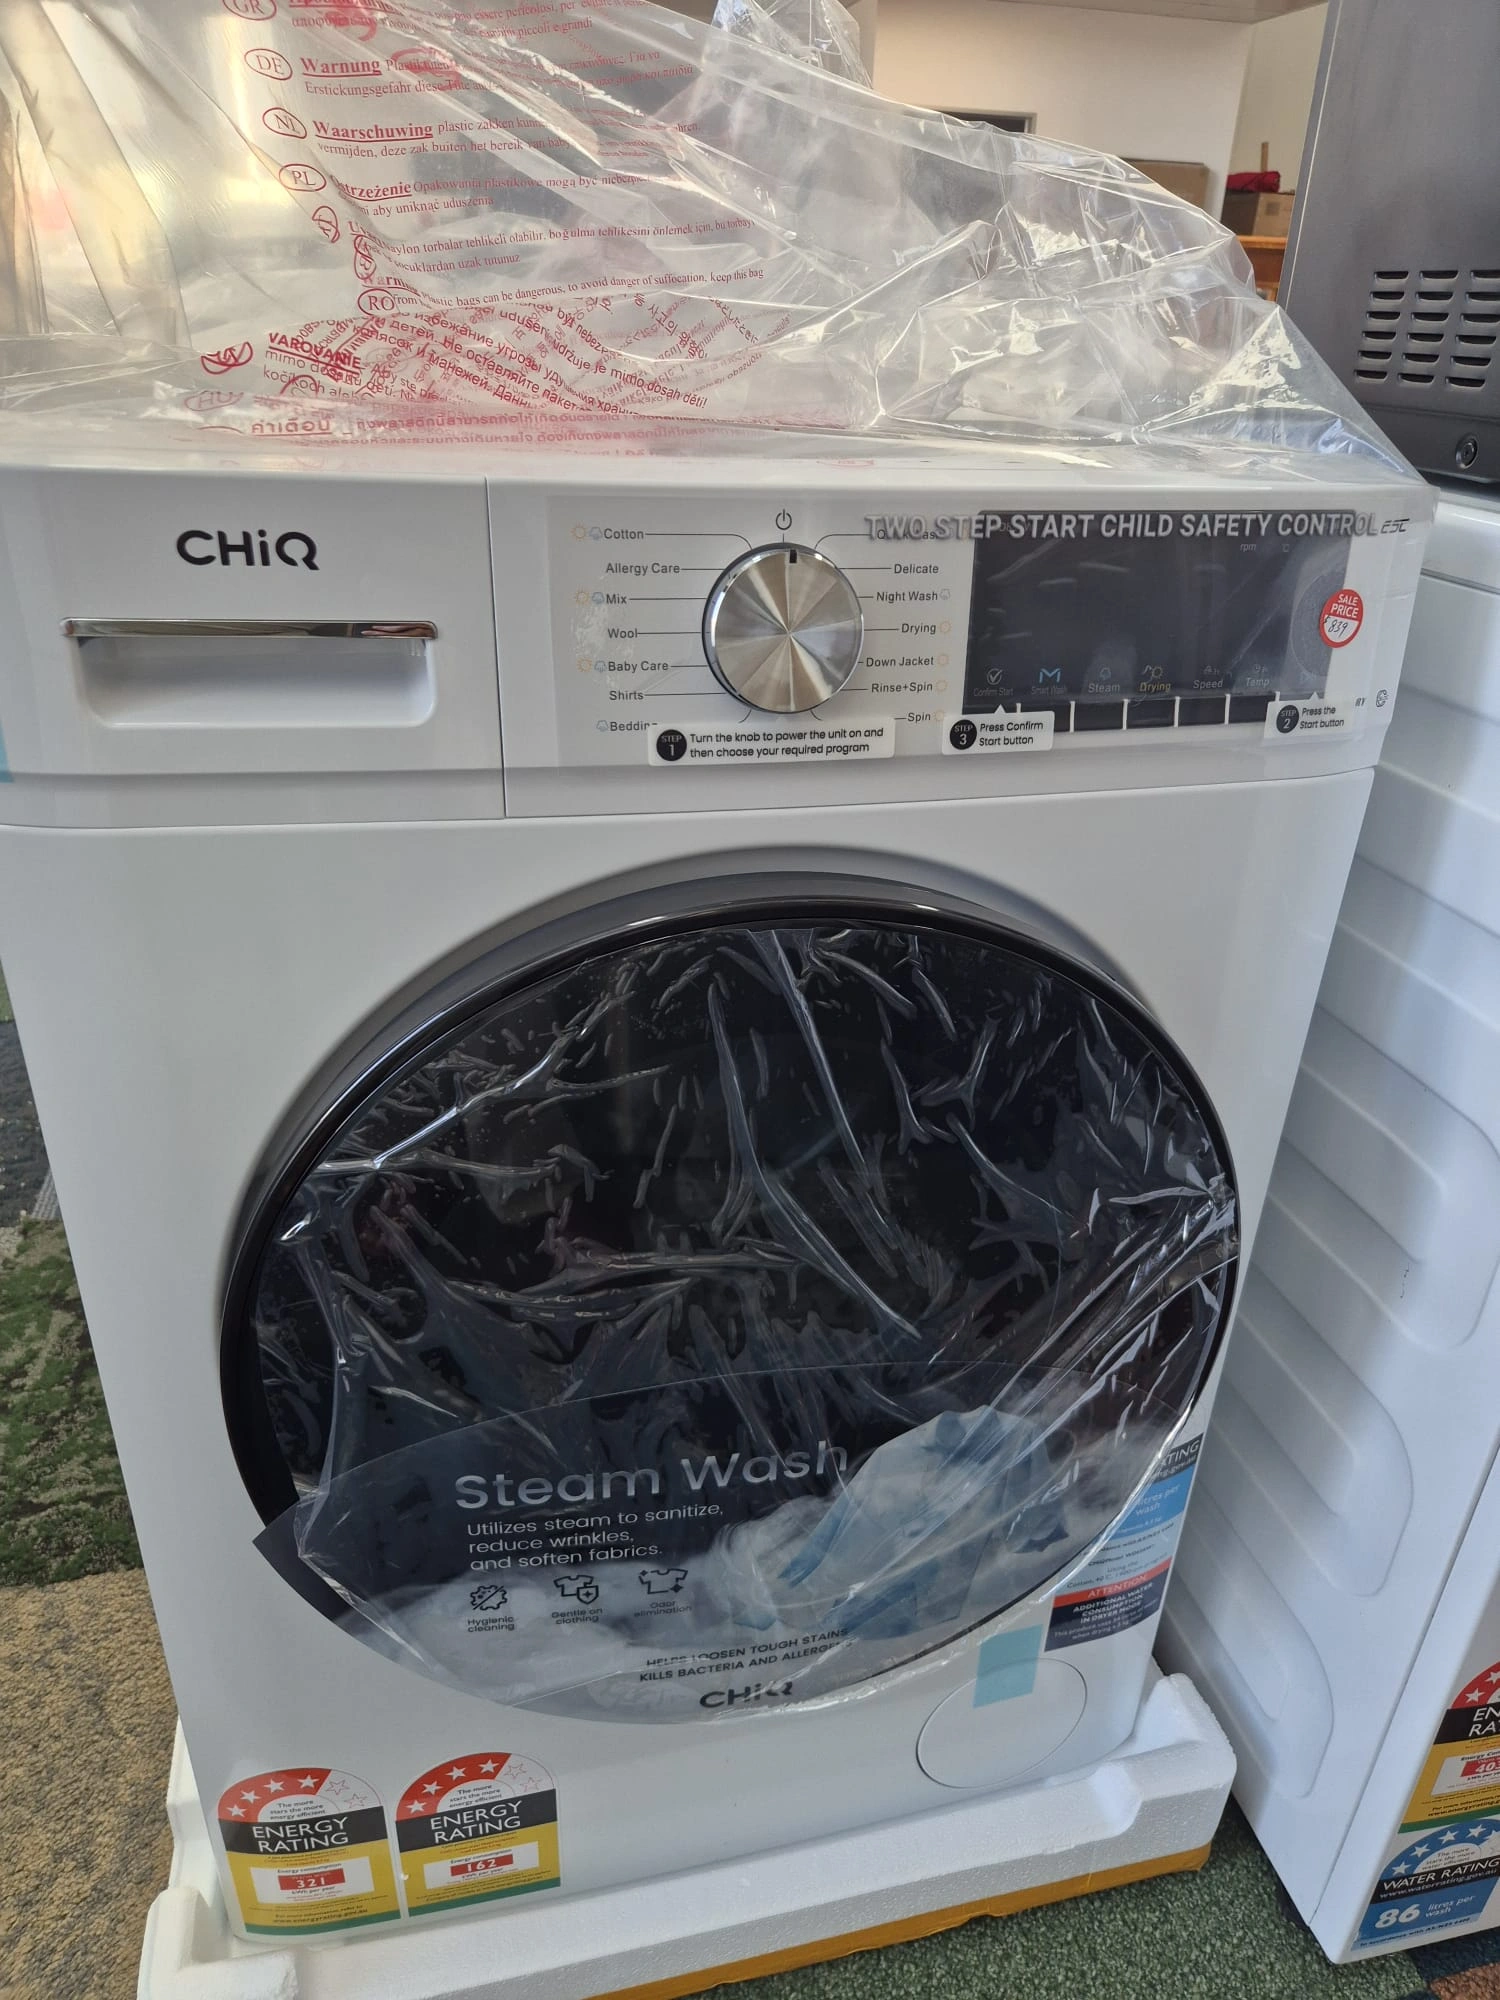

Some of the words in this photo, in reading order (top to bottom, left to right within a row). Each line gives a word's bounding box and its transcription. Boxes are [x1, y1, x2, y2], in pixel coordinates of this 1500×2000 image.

[256, 55, 284, 75] DE
[300, 57, 381, 75] Warnung
[305, 81, 411, 98] Erstickungsgefahr
[313, 118, 433, 140] Waarschuwing
[438, 120, 473, 134] plastic
[319, 141, 377, 159] vermijden,
[381, 144, 406, 157] deze
[410, 141, 428, 153] zak
[432, 140, 467, 152] buiten
[490, 138, 523, 150] bereik
[292, 171, 316, 186] PL
[372, 204, 392, 218] aby
[423, 236, 464, 252] torbalar
[466, 232, 507, 248] tehlikeli
[456, 296, 481, 308] bags
[483, 295, 500, 304] can
[501, 290, 512, 300] be
[515, 286, 566, 300] dangerous,
[568, 283, 578, 292] to
[581, 277, 608, 290] avoid
[610, 275, 640, 288] danger
[642, 274, 653, 285] of
[655, 271, 707, 285] suffocation,
[710, 271, 732, 284] keep
[734, 269, 748, 281] this
[748, 267, 764, 279] bag
[368, 294, 395, 311] RO
[864, 514, 926, 540] TWO
[934, 515, 1002, 540] STEP
[1009, 514, 1095, 540] START
[1101, 513, 1174, 538] CHILD
[1179, 513, 1272, 538] SAFETY
[1277, 512, 1379, 537] CONTROL
[603, 528, 644, 540] Cotton
[176, 529, 320, 571] CHiQ
[605, 563, 648, 575] Allergy
[651, 563, 680, 574] Care
[894, 563, 939, 575] Delicate
[606, 594, 627, 605] Mix
[876, 591, 905, 604] Night
[908, 591, 938, 601] Wash
[1337, 594, 1359, 607] SALE
[1330, 603, 1359, 618] PRICE
[607, 628, 638, 640] Wool
[901, 623, 937, 635] Drying
[608, 661, 638, 674] Baby
[640, 661, 669, 672] Care
[866, 657, 896, 667] Down
[898, 656, 934, 667] Jacket
[871, 682, 933, 695] Rinse+Spin
[1088, 682, 1121, 693] Steam
[1139, 682, 1172, 693] Drying
[1193, 680, 1224, 690] Speed
[1246, 677, 1271, 688] Temp
[609, 690, 644, 702] Shirts
[1280, 709, 1296, 717] STEP
[1301, 707, 1322, 716] Press
[1323, 706, 1336, 715] the
[907, 712, 931, 724] Spin
[1283, 718, 1291, 729] 2
[1299, 720, 1318, 729] Start
[1320, 719, 1345, 728] button
[954, 724, 973, 732] STEP
[980, 723, 1004, 732] Press
[1006, 721, 1044, 731] Confirm
[660, 734, 682, 743] STEP
[690, 734, 713, 743] Turn
[715, 733, 732, 742] the
[735, 732, 760, 742] knob
[763, 732, 773, 741] to
[775, 731, 807, 743] power
[810, 730, 825, 739] the
[828, 728, 847, 738] unit
[849, 729, 862, 738] on
[864, 727, 884, 737] and
[959, 733, 967, 745] 3
[979, 737, 1001, 746] Start
[1003, 736, 1034, 746] button
[669, 744, 675, 756] 1
[690, 748, 713, 758] then
[716, 747, 754, 757] choose
[757, 747, 779, 759] your
[781, 744, 823, 757] required
[826, 744, 869, 756] program
[455, 1468, 660, 1509] Steam
[681, 1440, 848, 1490] Wash
[467, 1521, 537, 1537] Utilizes
[544, 1515, 611, 1531] steam
[618, 1512, 638, 1524] to
[645, 1503, 723, 1522] sanitize,
[469, 1539, 543, 1554] reduce
[550, 1531, 634, 1548] wrinkles,
[470, 1556, 511, 1571] and
[518, 1552, 582, 1567] soften
[589, 1544, 663, 1560] fabrics.
[1088, 1575, 1147, 1599] ATTENTION
[1073, 1595, 1127, 1613] ADDITIONAL
[552, 1610, 586, 1619] Gentle
[589, 1607, 603, 1615] on
[468, 1616, 514, 1627] Hygienic
[556, 1615, 600, 1625] clothing
[468, 1623, 515, 1633] cleaning
[749, 1639, 798, 1655] TOUGH
[801, 1627, 851, 1645] STAINS
[640, 1670, 673, 1681] KILLS
[677, 1661, 744, 1677] BACTERIA
[748, 1655, 777, 1668] AND
[430, 1800, 522, 1830] ENERGY
[252, 1816, 348, 1839] ENERGY
[435, 1816, 521, 1844] RATING
[257, 1831, 349, 1853] RATING
[467, 1859, 497, 1872] 162
[1383, 1871, 1436, 1890] WATER
[1441, 1857, 1500, 1879] RATING
[296, 1876, 326, 1889] 321
[1375, 1903, 1420, 1929] 86
